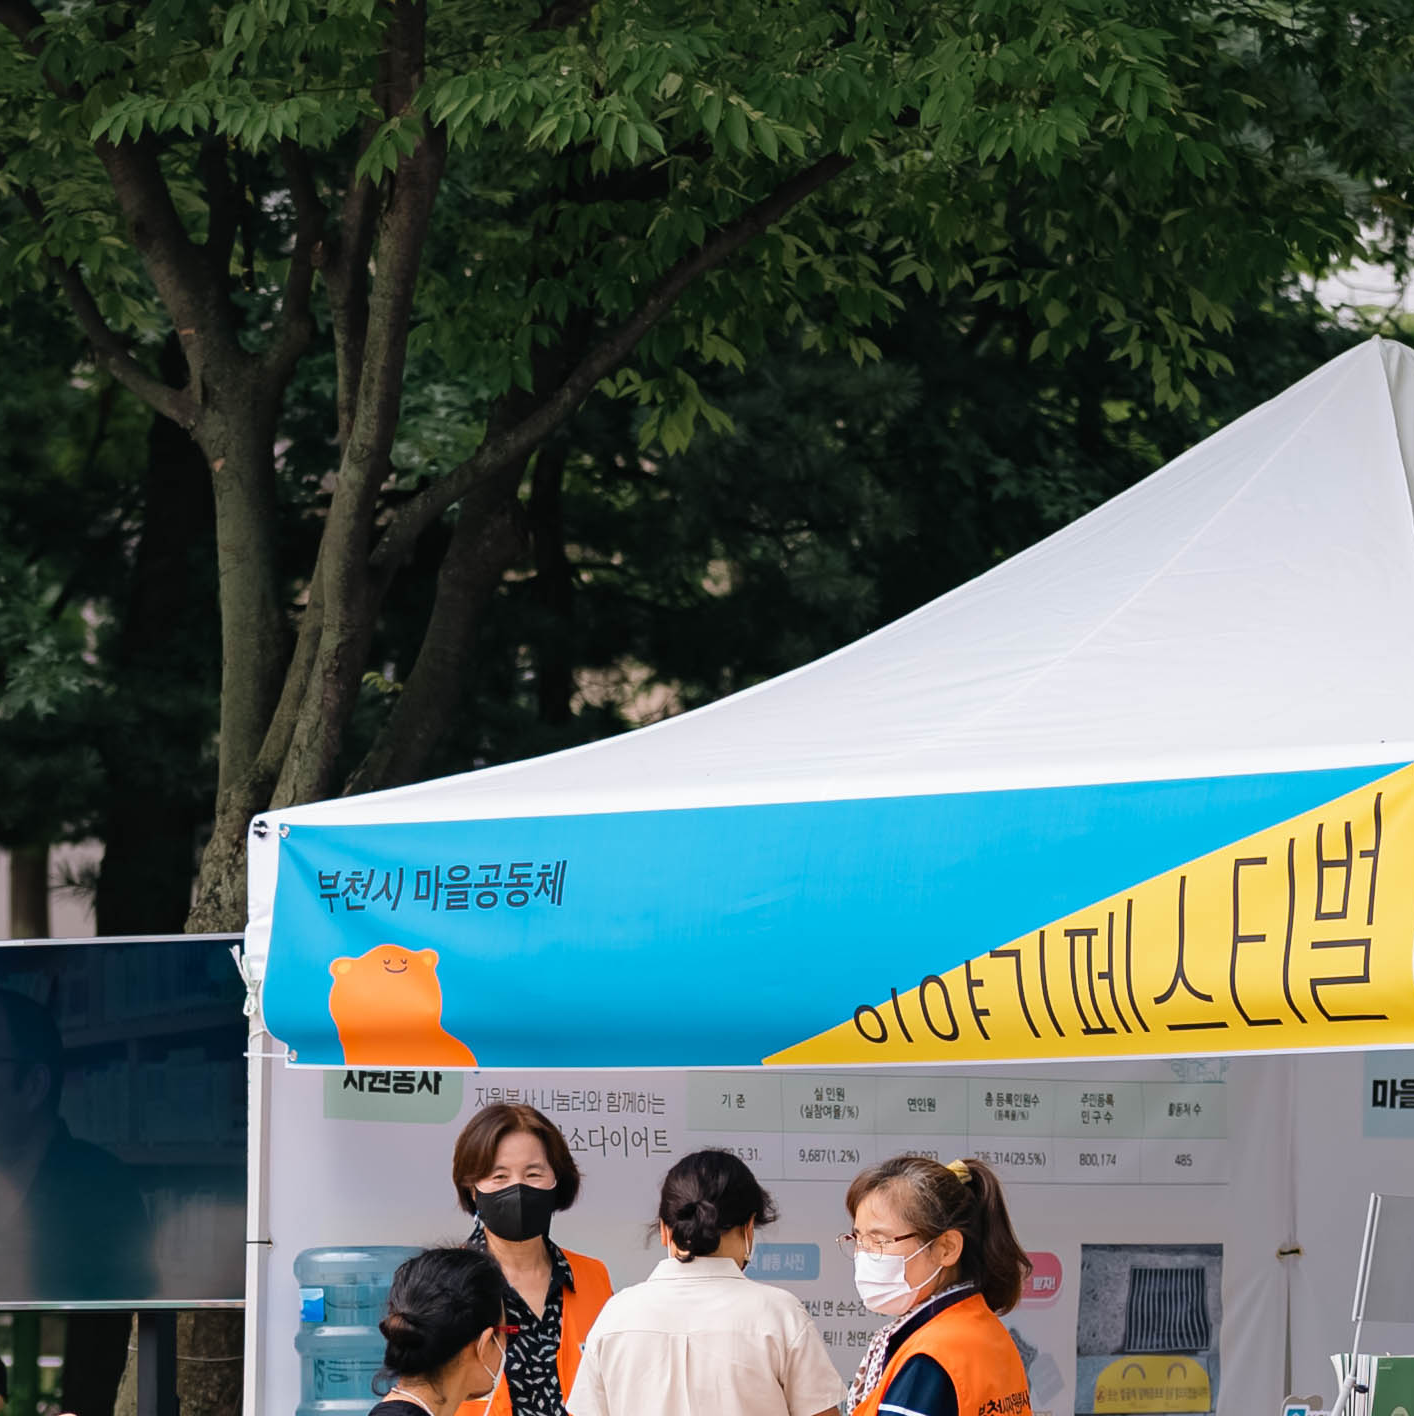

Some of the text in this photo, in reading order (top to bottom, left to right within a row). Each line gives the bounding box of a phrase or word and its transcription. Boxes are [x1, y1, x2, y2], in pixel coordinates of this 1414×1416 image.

[319, 860, 569, 913] 부천시 마을공동체
[541, 1089, 602, 1112] 나눔터와
[605, 1091, 667, 1115] 함께하는
[907, 1097, 937, 1112] 연인원
[557, 1125, 672, 1158] 소다이어트
[799, 1149, 860, 1164] 9,687(1.2%)
[1079, 1153, 1117, 1168] 800,174
[1174, 1154, 1193, 1167] 485
